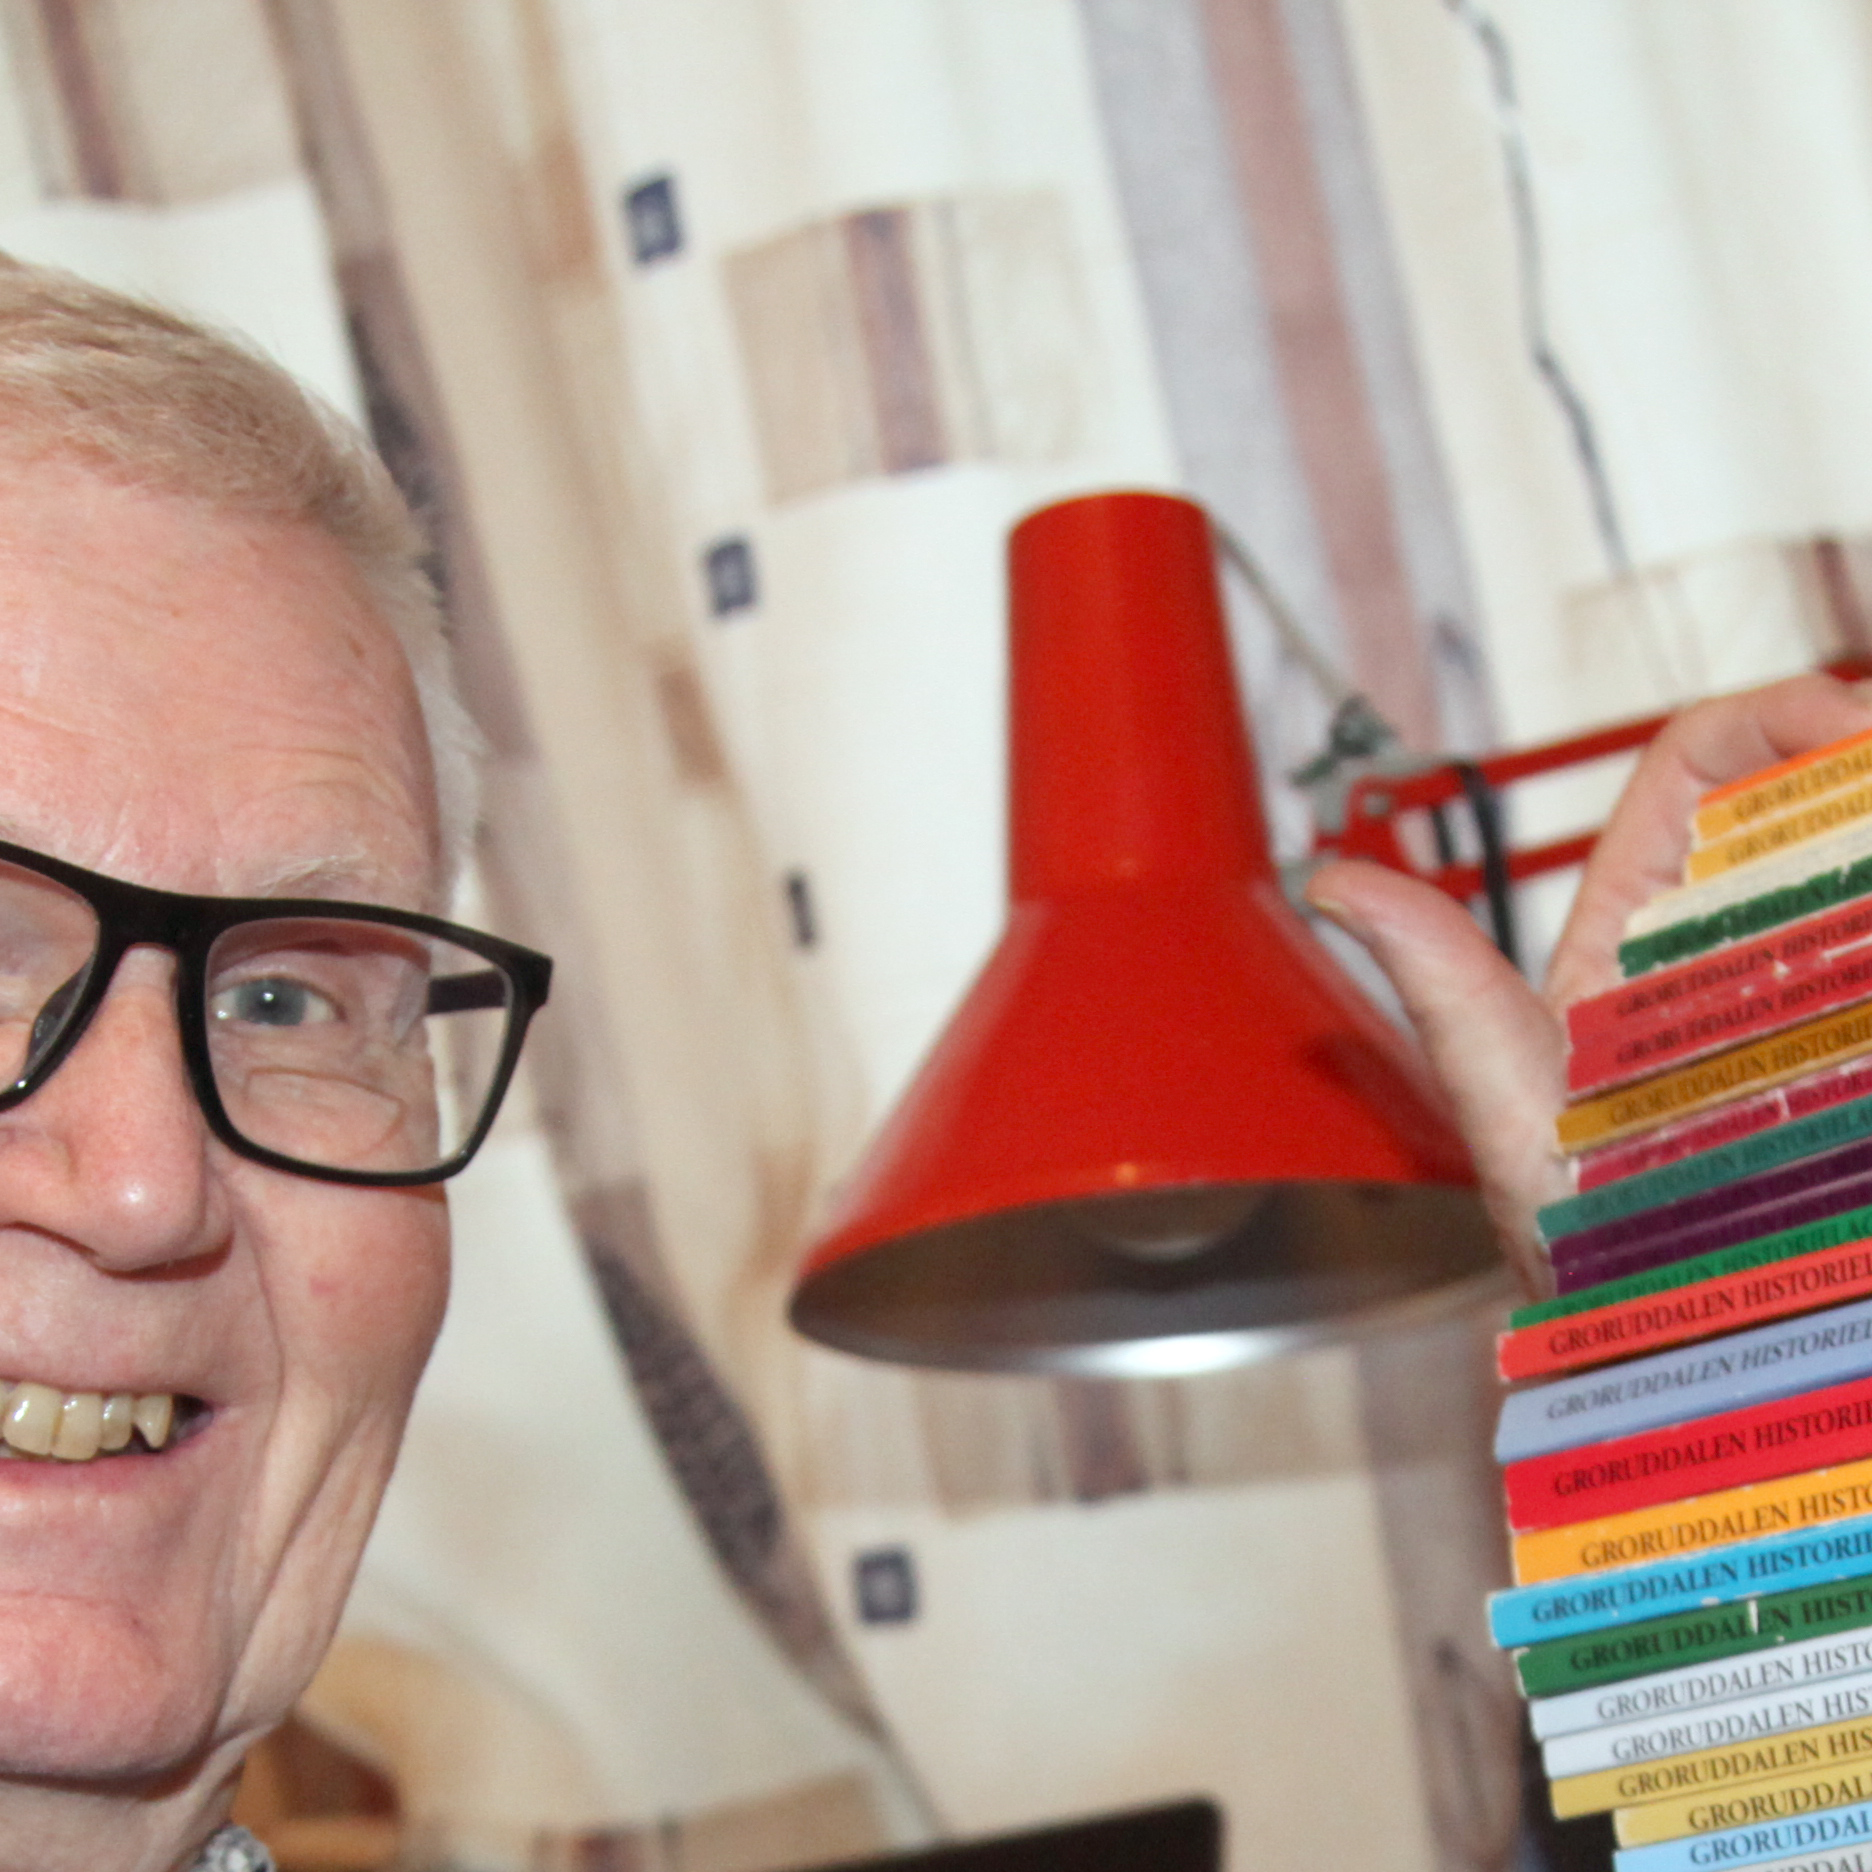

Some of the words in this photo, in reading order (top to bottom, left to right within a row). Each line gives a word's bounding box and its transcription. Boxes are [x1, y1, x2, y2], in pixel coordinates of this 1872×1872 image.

[1578, 1499, 1792, 1568] GRORUDDALEN
[1595, 1658, 1794, 1723] GRORUDDALEN
[1610, 1700, 1814, 1764] GRORUDDALEN
[1617, 1736, 1819, 1798] GRORUDDALEN
